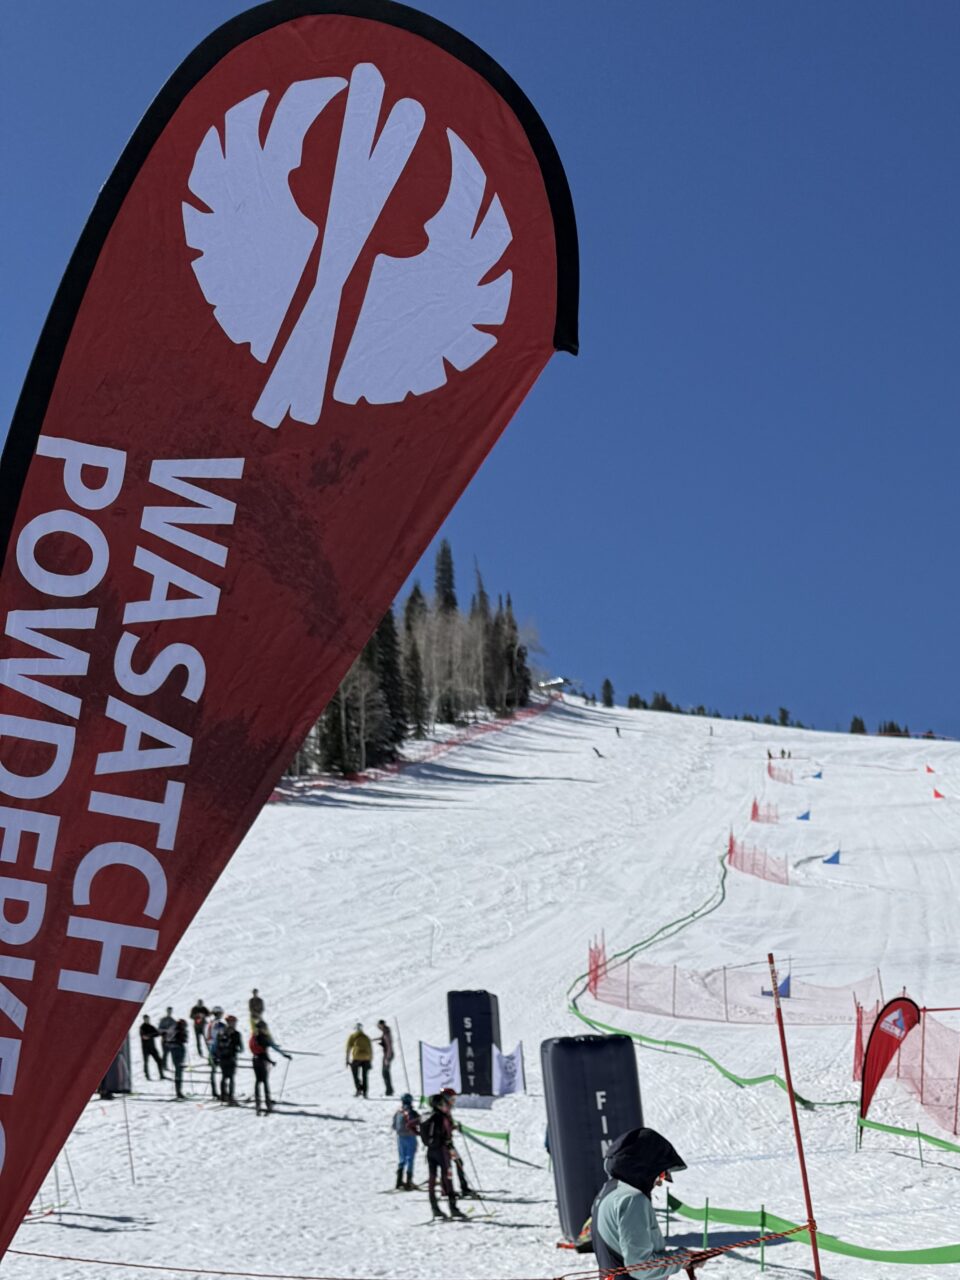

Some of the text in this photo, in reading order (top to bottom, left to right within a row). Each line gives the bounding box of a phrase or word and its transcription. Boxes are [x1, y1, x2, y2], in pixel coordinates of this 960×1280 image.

[0, 434, 128, 1178] POWDER
[57, 456, 245, 1000] WASATCH
[463, 1017, 475, 1087] START
